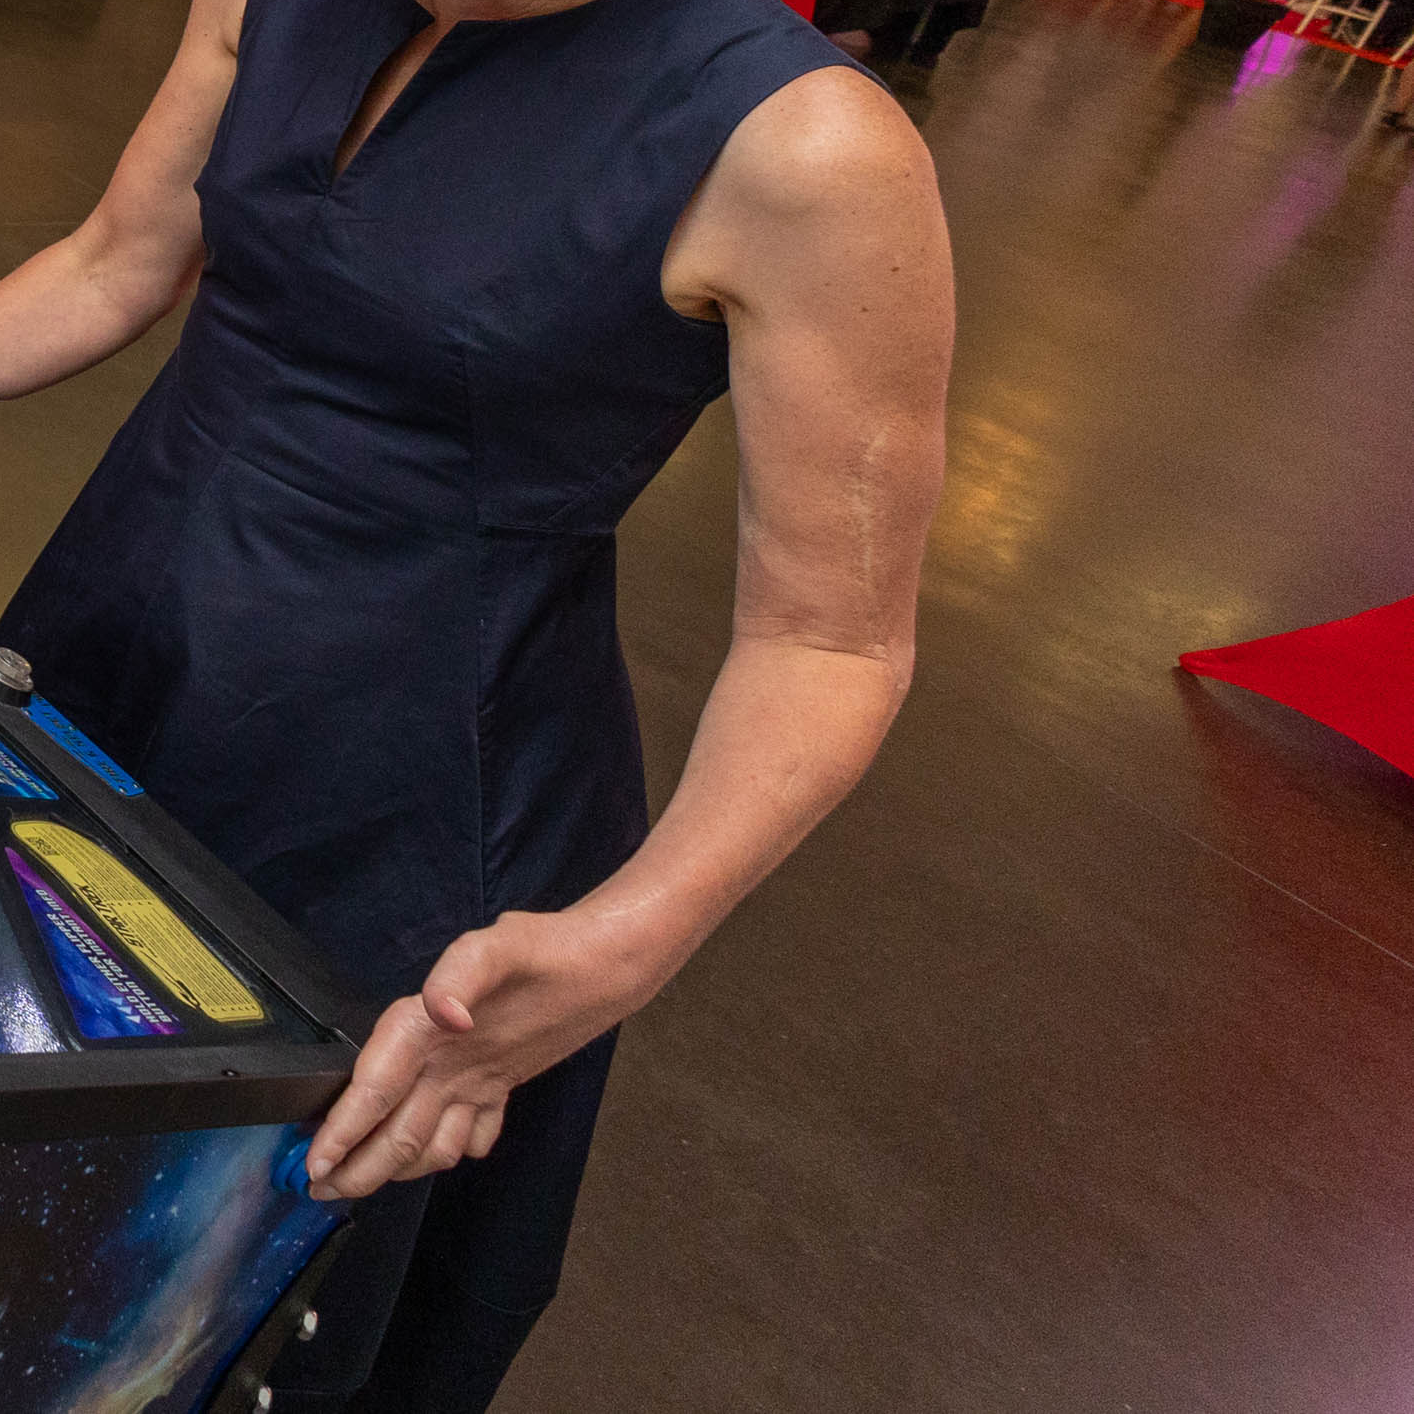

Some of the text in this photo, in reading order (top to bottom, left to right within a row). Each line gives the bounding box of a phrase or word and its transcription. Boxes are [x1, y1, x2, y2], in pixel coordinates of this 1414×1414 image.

[35, 889, 173, 1024] BUTTON FOR INSTANT INFO
[46, 912, 161, 1024] HOLD EITHER FLIPPER
[73, 882, 144, 947] STAR TREK
